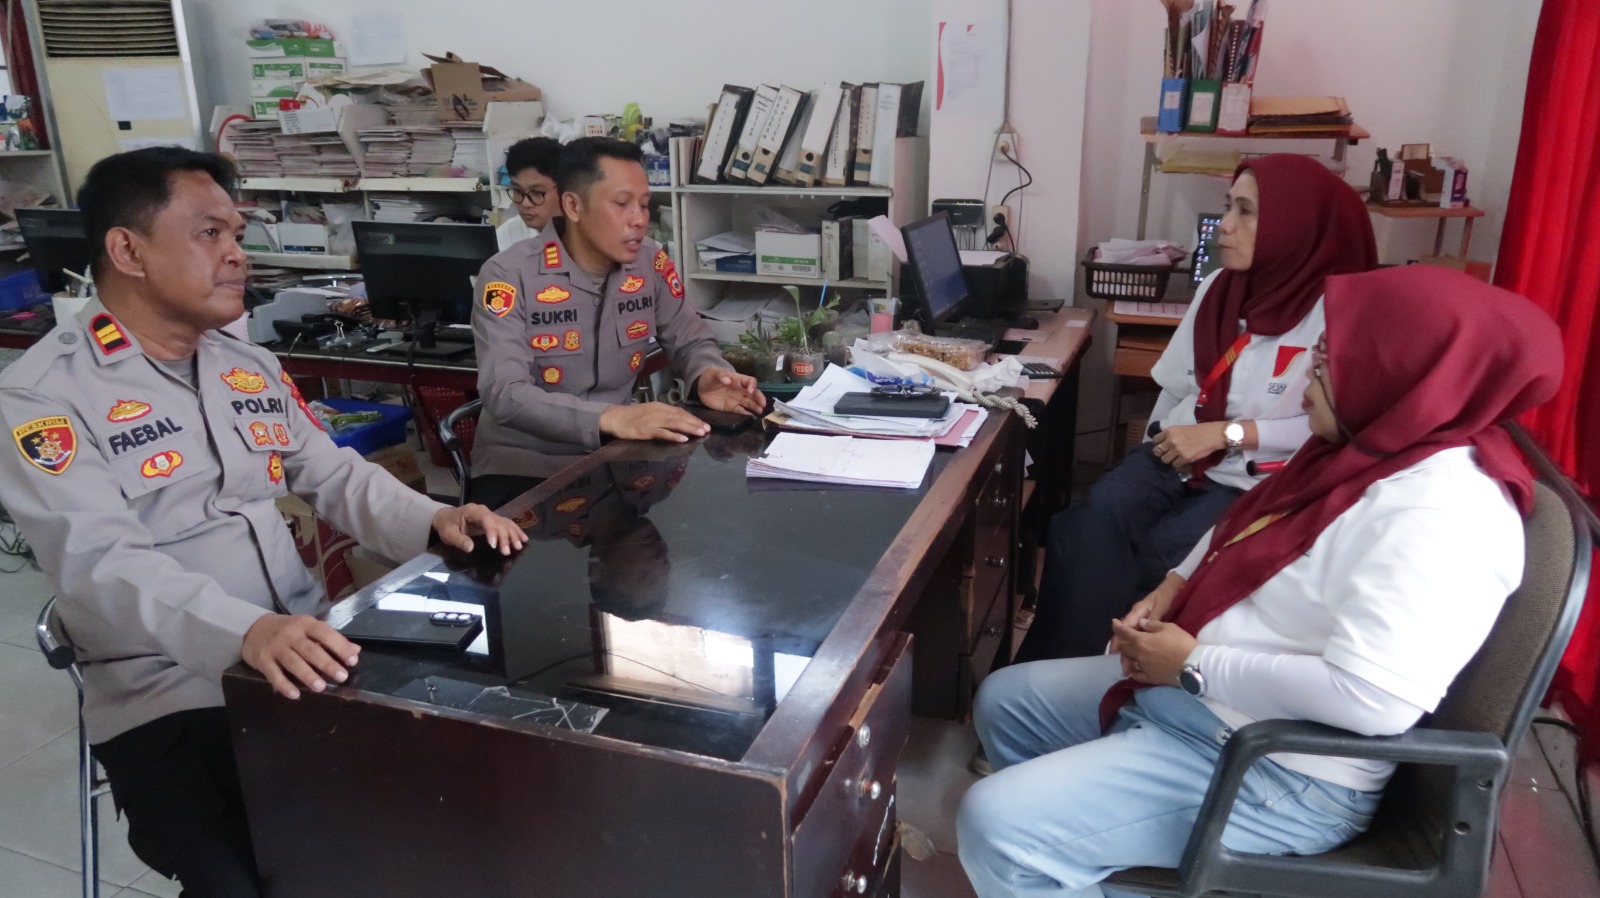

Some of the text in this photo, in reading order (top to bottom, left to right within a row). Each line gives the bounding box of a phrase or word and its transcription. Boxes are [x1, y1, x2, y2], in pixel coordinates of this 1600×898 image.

[618, 296, 652, 315] POLRI
[531, 309, 577, 325] SUKRI
[231, 397, 284, 415] POLRI
[109, 417, 183, 455] FAESAL
